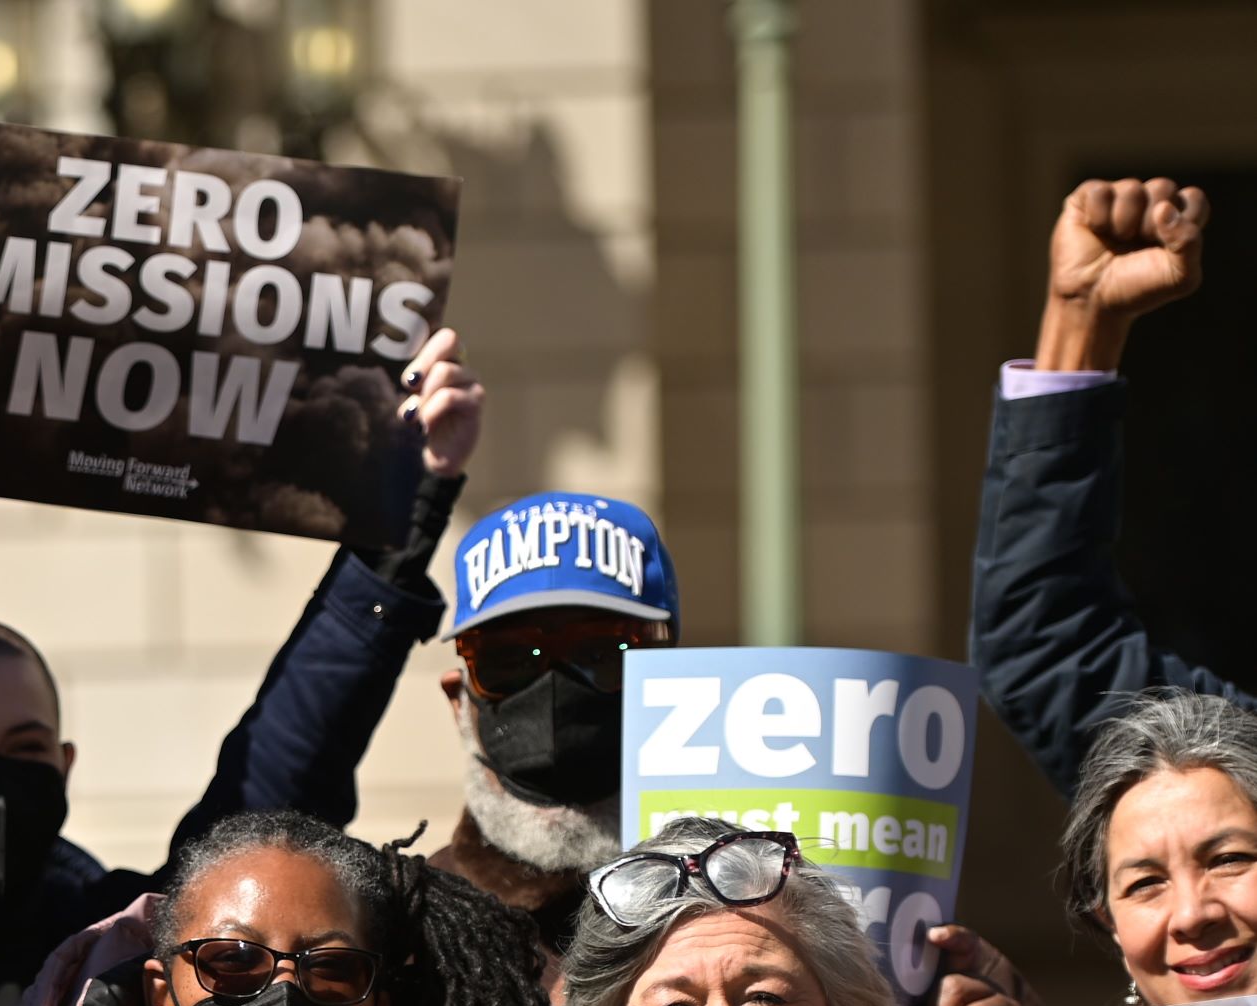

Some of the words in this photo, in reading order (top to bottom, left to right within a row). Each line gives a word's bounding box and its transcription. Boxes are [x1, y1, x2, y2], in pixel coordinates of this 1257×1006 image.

[48, 156, 303, 261] ZERO
[7, 330, 300, 447] NOW
[68, 450, 125, 476] Moving
[126, 457, 191, 479] Forward
[124, 473, 188, 498] Network
[463, 510, 646, 611] HAMPTON
[638, 673, 965, 790] zero
[819, 808, 948, 863] mean
